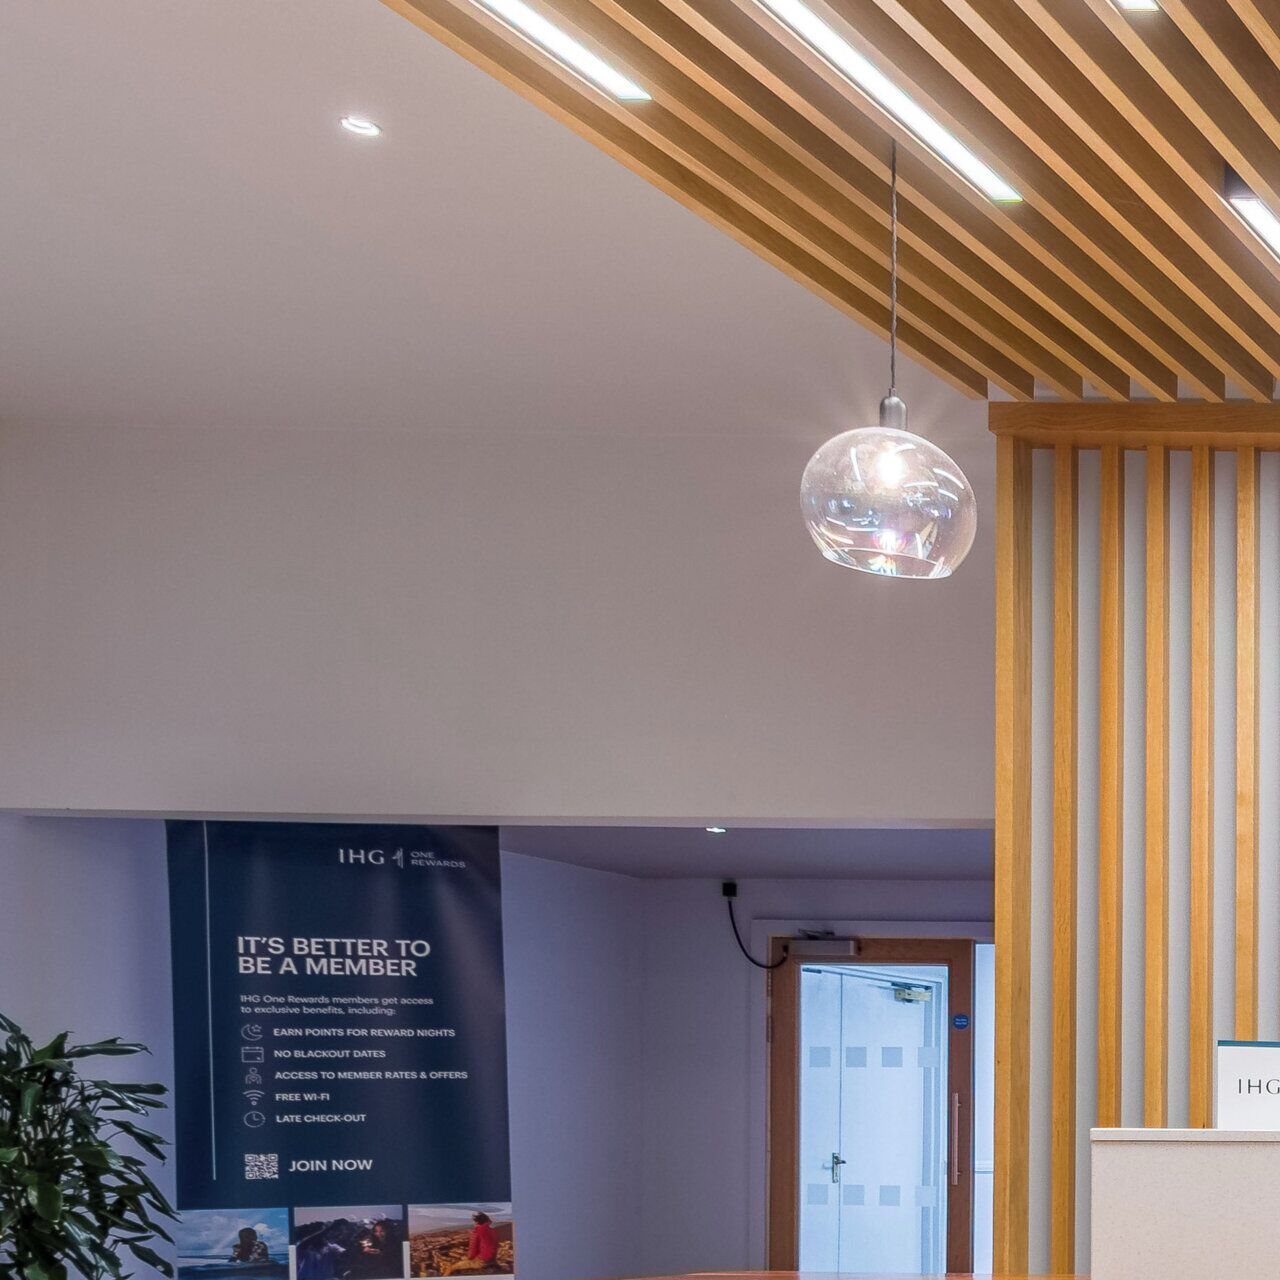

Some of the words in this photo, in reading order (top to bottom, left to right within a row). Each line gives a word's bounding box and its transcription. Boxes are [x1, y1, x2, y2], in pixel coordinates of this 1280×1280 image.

[339, 848, 385, 865] IHG
[411, 851, 435, 859] ONE
[411, 859, 466, 869] REWARDS
[238, 936, 285, 955] IT'S
[293, 937, 389, 956] BETTER
[395, 940, 431, 957] TO
[238, 957, 272, 974] BE
[278, 957, 298, 975] A
[306, 958, 417, 976] MEMBER
[240, 994, 261, 1003] IHG
[263, 994, 286, 1003] One
[287, 995, 330, 1004] Rewards
[332, 996, 379, 1005] members
[381, 997, 398, 1006] get
[241, 1006, 252, 1014] to
[254, 1006, 300, 1014] exclusive
[303, 1006, 345, 1015] benefits,
[347, 1007, 396, 1016] including:
[273, 1028, 303, 1037] EARN
[305, 1028, 345, 1037] POINTS
[346, 1029, 368, 1037] FOR
[370, 1029, 415, 1037] REWARD
[417, 1029, 456, 1037] NIGHTS
[274, 1050, 292, 1058] NO
[293, 1050, 351, 1058] BLACKOUT
[353, 1050, 386, 1058] DATES
[275, 1071, 318, 1080] ACCESS
[320, 1071, 336, 1079] TO
[338, 1071, 383, 1079] MEMBER
[385, 1071, 418, 1079] RATES
[420, 1071, 428, 1079] &
[429, 1071, 468, 1079] OFFERS
[1238, 1078, 1280, 1095] IHG
[275, 1093, 301, 1101] FREE
[303, 1093, 330, 1101] WI-FI
[276, 1115, 302, 1123] LATE
[304, 1114, 367, 1122] CHECK-OUT
[288, 1160, 327, 1172] JOIN
[332, 1159, 373, 1171] NOW
